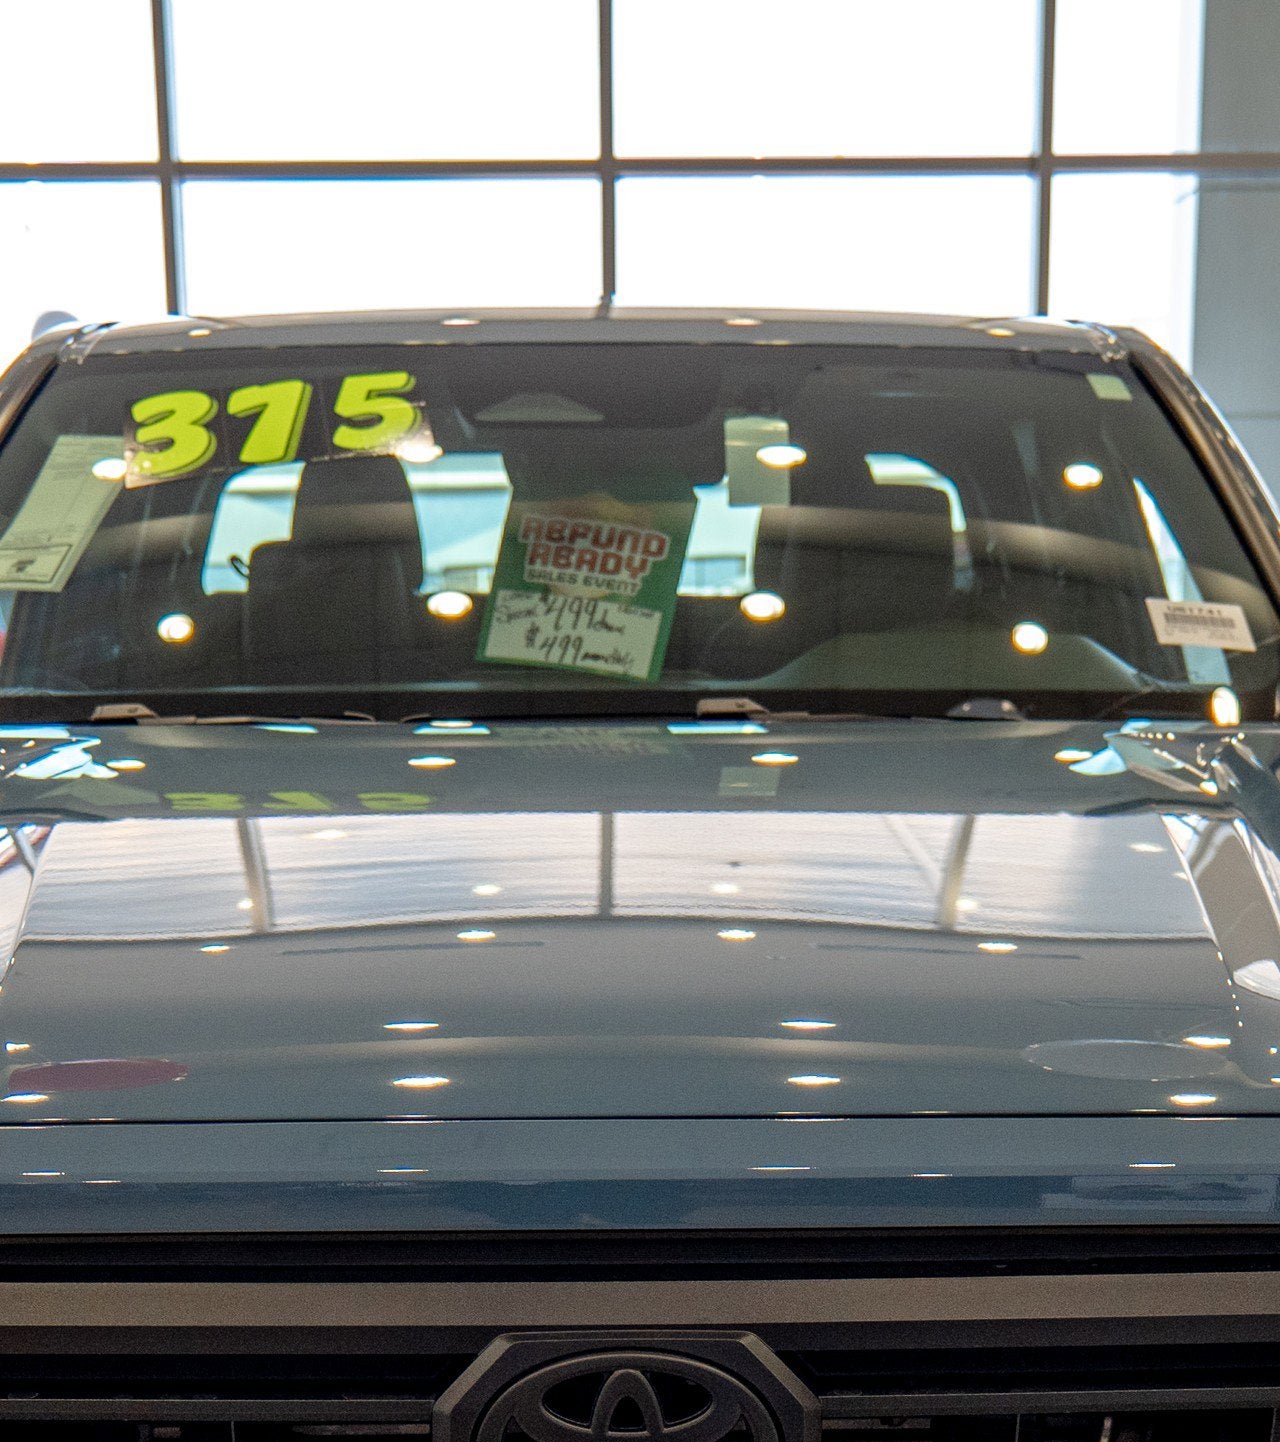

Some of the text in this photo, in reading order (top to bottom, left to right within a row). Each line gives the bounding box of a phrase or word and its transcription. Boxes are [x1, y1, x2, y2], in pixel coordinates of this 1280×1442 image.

[522, 518, 667, 558] REFUND
[528, 542, 648, 580] READY
[583, 574, 641, 595] EVENT
